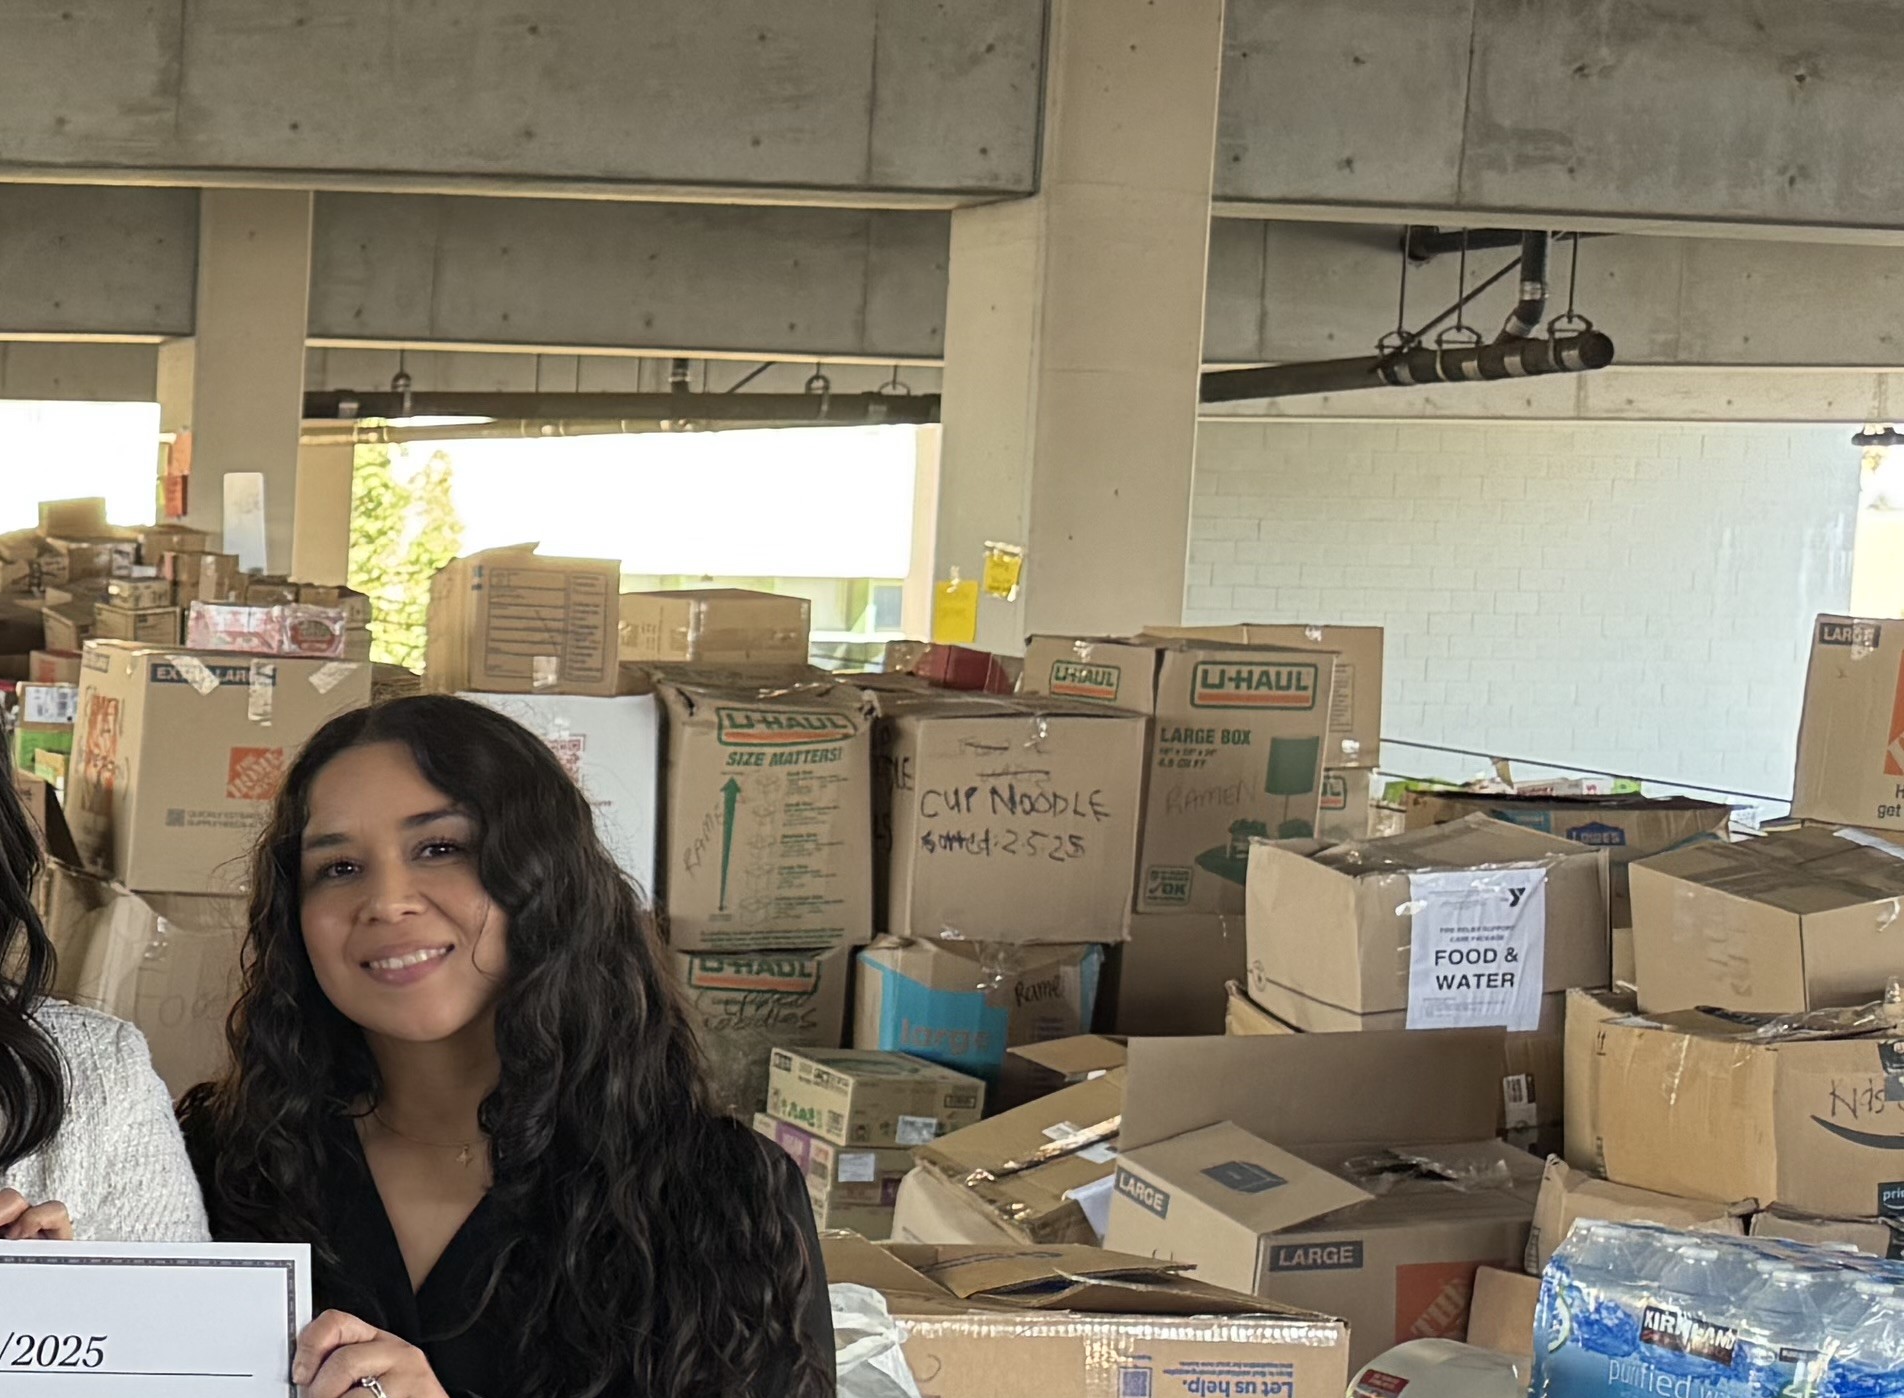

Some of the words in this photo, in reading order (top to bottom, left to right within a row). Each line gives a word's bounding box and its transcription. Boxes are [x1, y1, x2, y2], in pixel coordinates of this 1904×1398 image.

[1055, 666, 1115, 687] U-HAUL
[1200, 668, 1309, 691] U-HAUL
[726, 712, 848, 730] U-HAUL
[1160, 727, 1214, 744] LARGE
[1221, 729, 1251, 745] BOX
[726, 751, 766, 767] SIZE
[769, 748, 842, 767] MATTERS!
[921, 786, 978, 818] CUP
[990, 783, 1111, 822] NOODLE
[1877, 804, 1901, 818] get
[1161, 882, 1187, 895] OK
[1435, 949, 1497, 966] FOOD
[1504, 947, 1518, 962] &
[1436, 972, 1515, 990] WATER
[1119, 1174, 1163, 1212] LARGE
[1883, 1188, 1904, 1201] pri
[1279, 1247, 1354, 1267] LARGE
[1182, 1377, 1231, 1398] help.
[1235, 1383, 1257, 1394] us
[1261, 1381, 1293, 1398] Let
